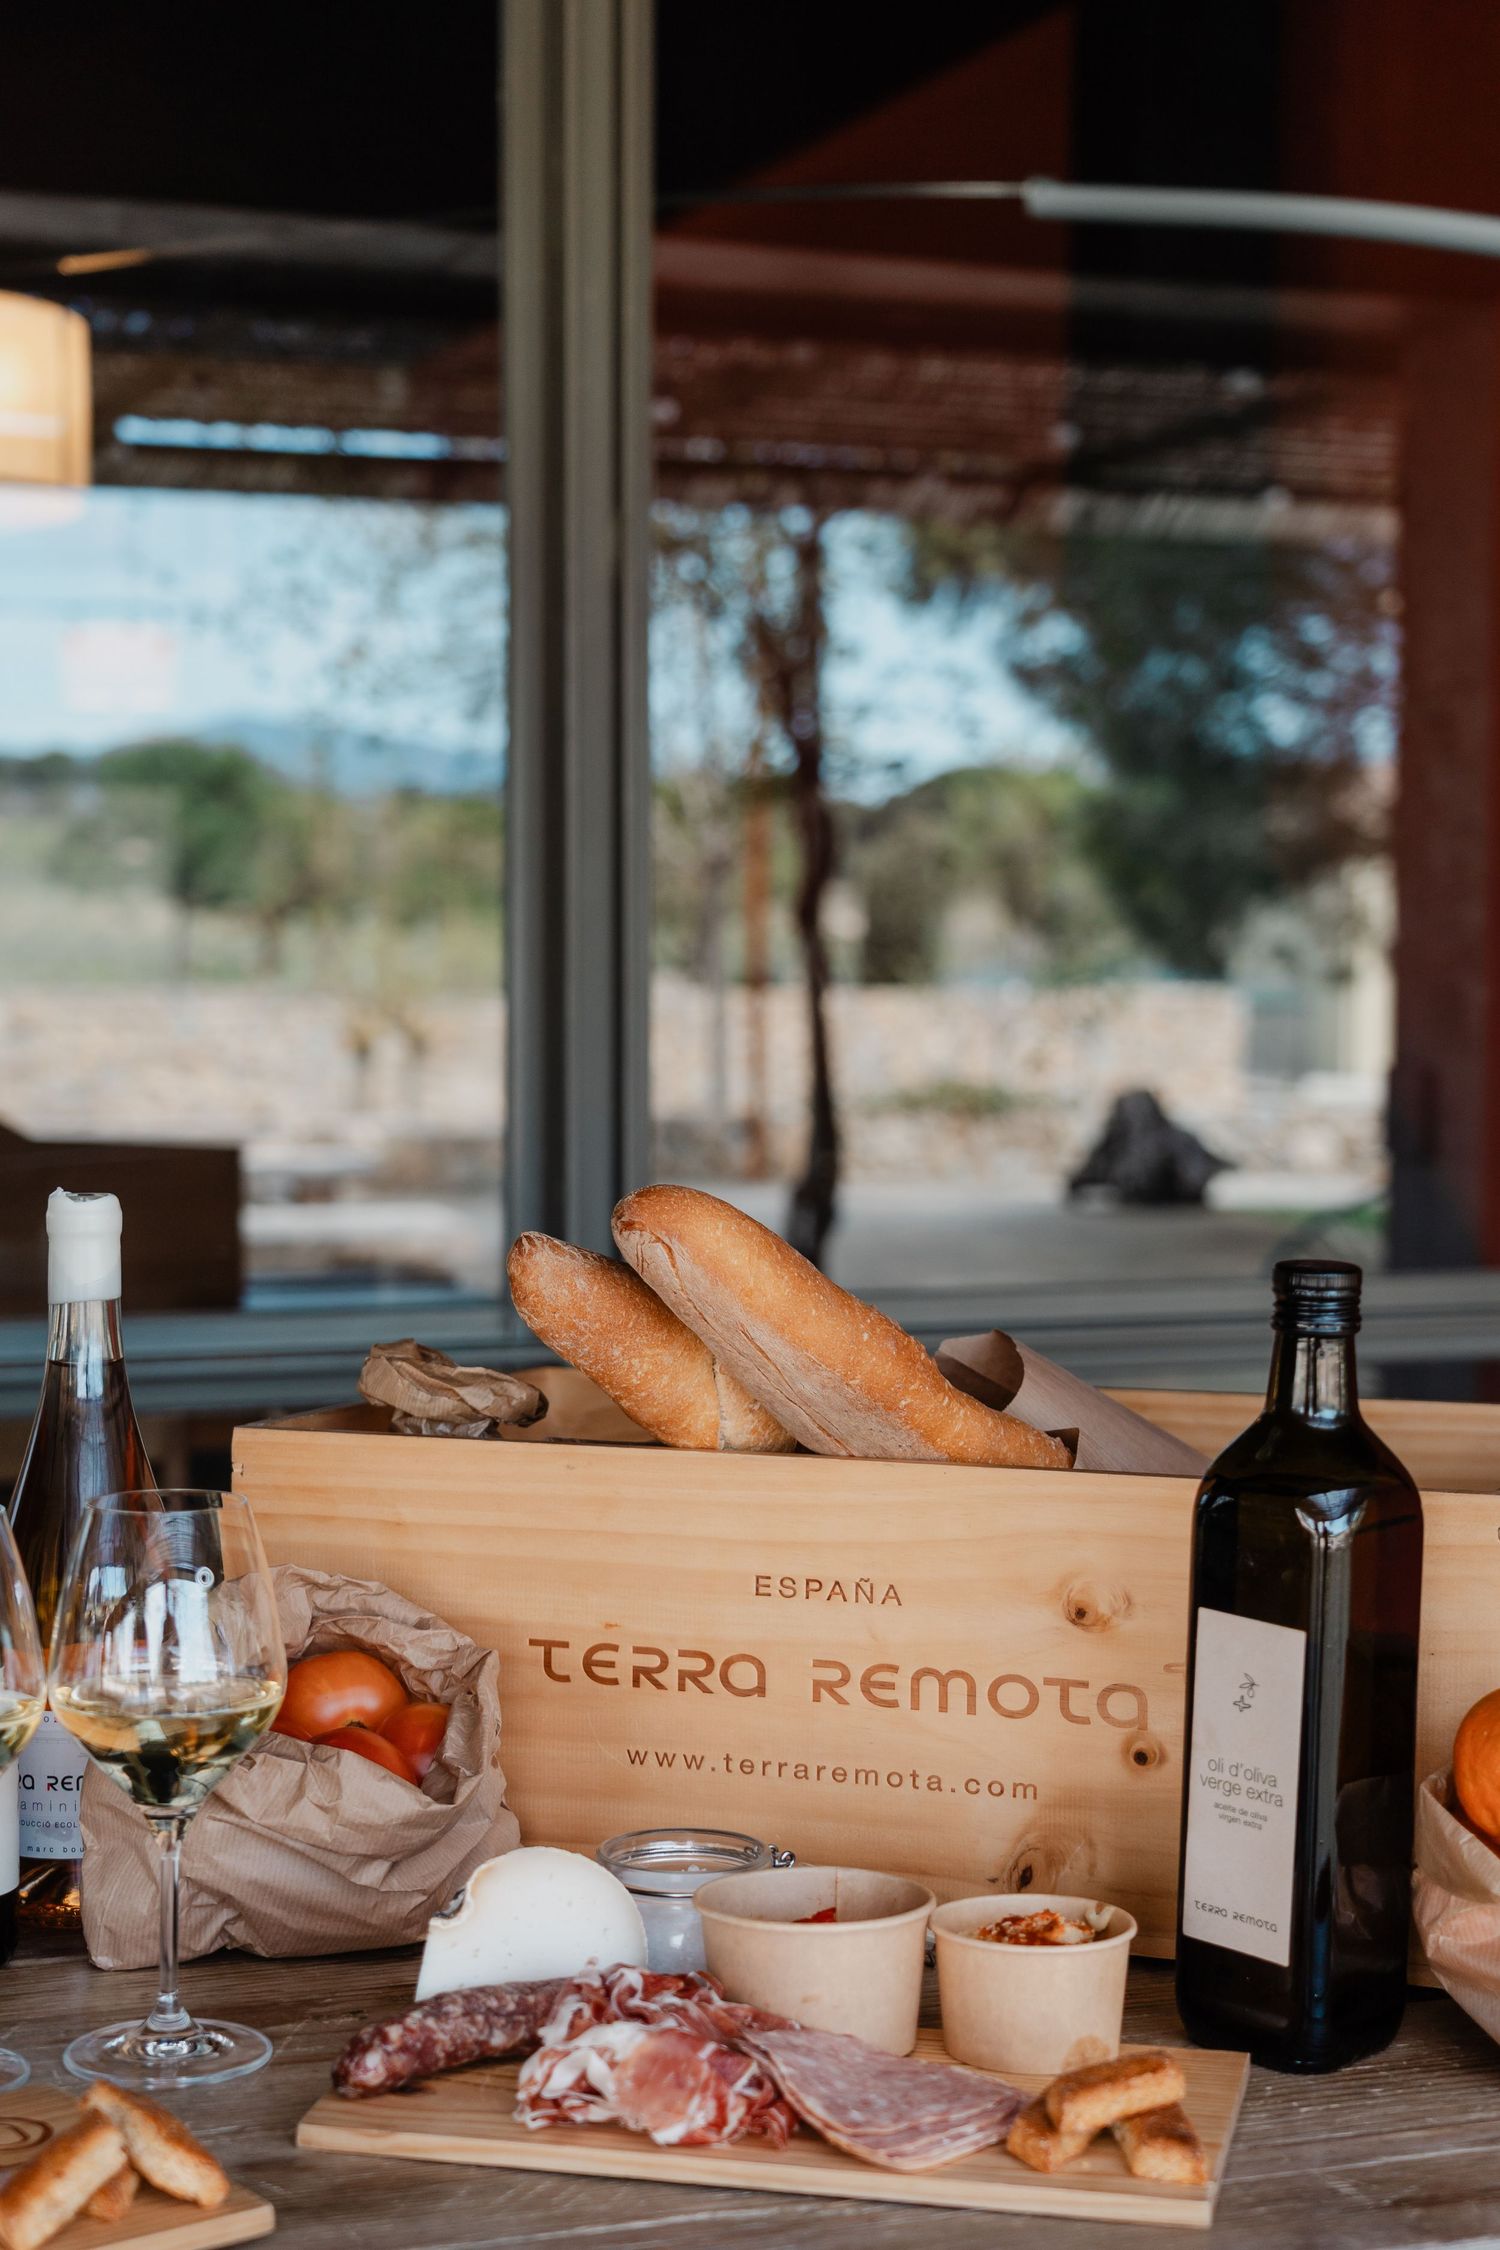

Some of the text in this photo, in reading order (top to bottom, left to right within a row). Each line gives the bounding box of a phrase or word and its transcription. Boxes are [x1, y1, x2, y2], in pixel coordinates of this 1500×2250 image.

[754, 1574, 903, 1607] ESPAÑA
[626, 1748, 1039, 1801] www.terraremota.com
[1207, 1757, 1278, 1788] oli d'oliva
[1199, 1773, 1284, 1808] verge extra
[1238, 1807, 1248, 1817] de
